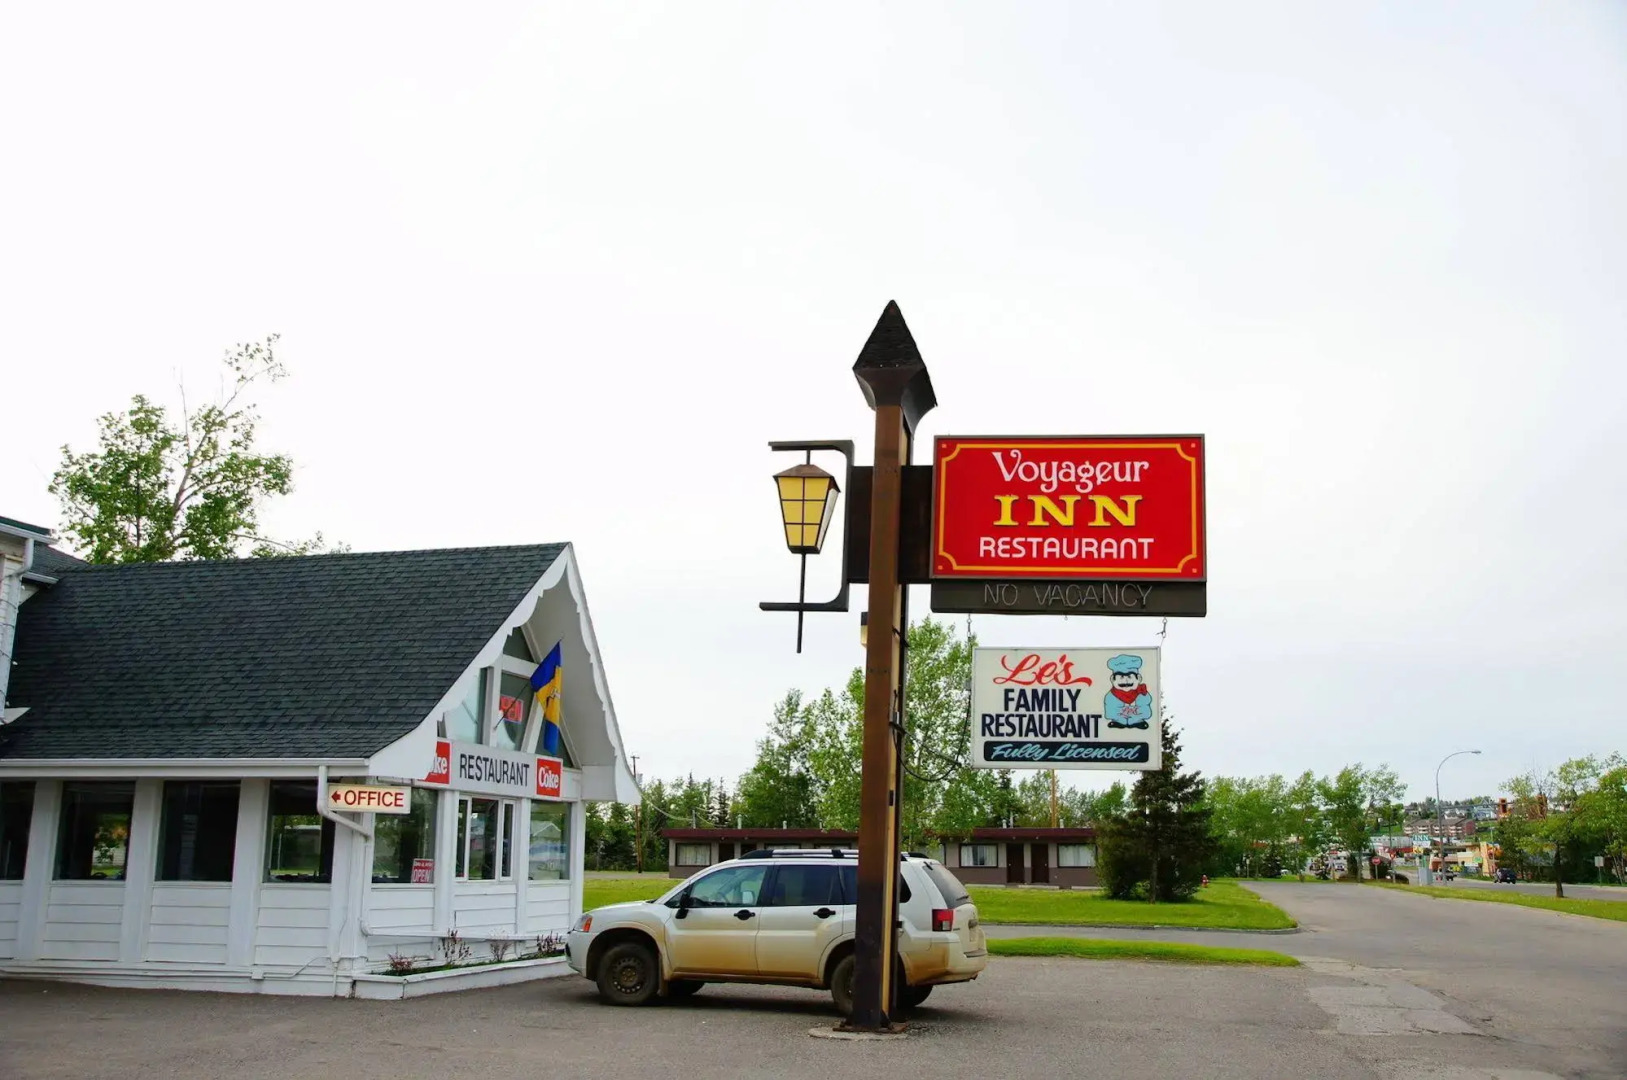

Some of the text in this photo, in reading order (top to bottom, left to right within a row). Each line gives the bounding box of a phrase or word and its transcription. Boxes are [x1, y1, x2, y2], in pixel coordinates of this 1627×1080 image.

[992, 449, 1149, 493] Voyageur
[993, 495, 1142, 526] INN
[979, 537, 1154, 559] RESTAURANT
[984, 583, 1152, 607] NO VACANCY
[993, 654, 1092, 687] Le's
[1004, 688, 1081, 712] FAMILY
[981, 714, 1102, 738] RESTAURANT
[990, 743, 1141, 761] Fully Licensed
[460, 753, 530, 787] RESTAURANT
[538, 766, 559, 788] Coke
[344, 790, 404, 807] OFFICE
